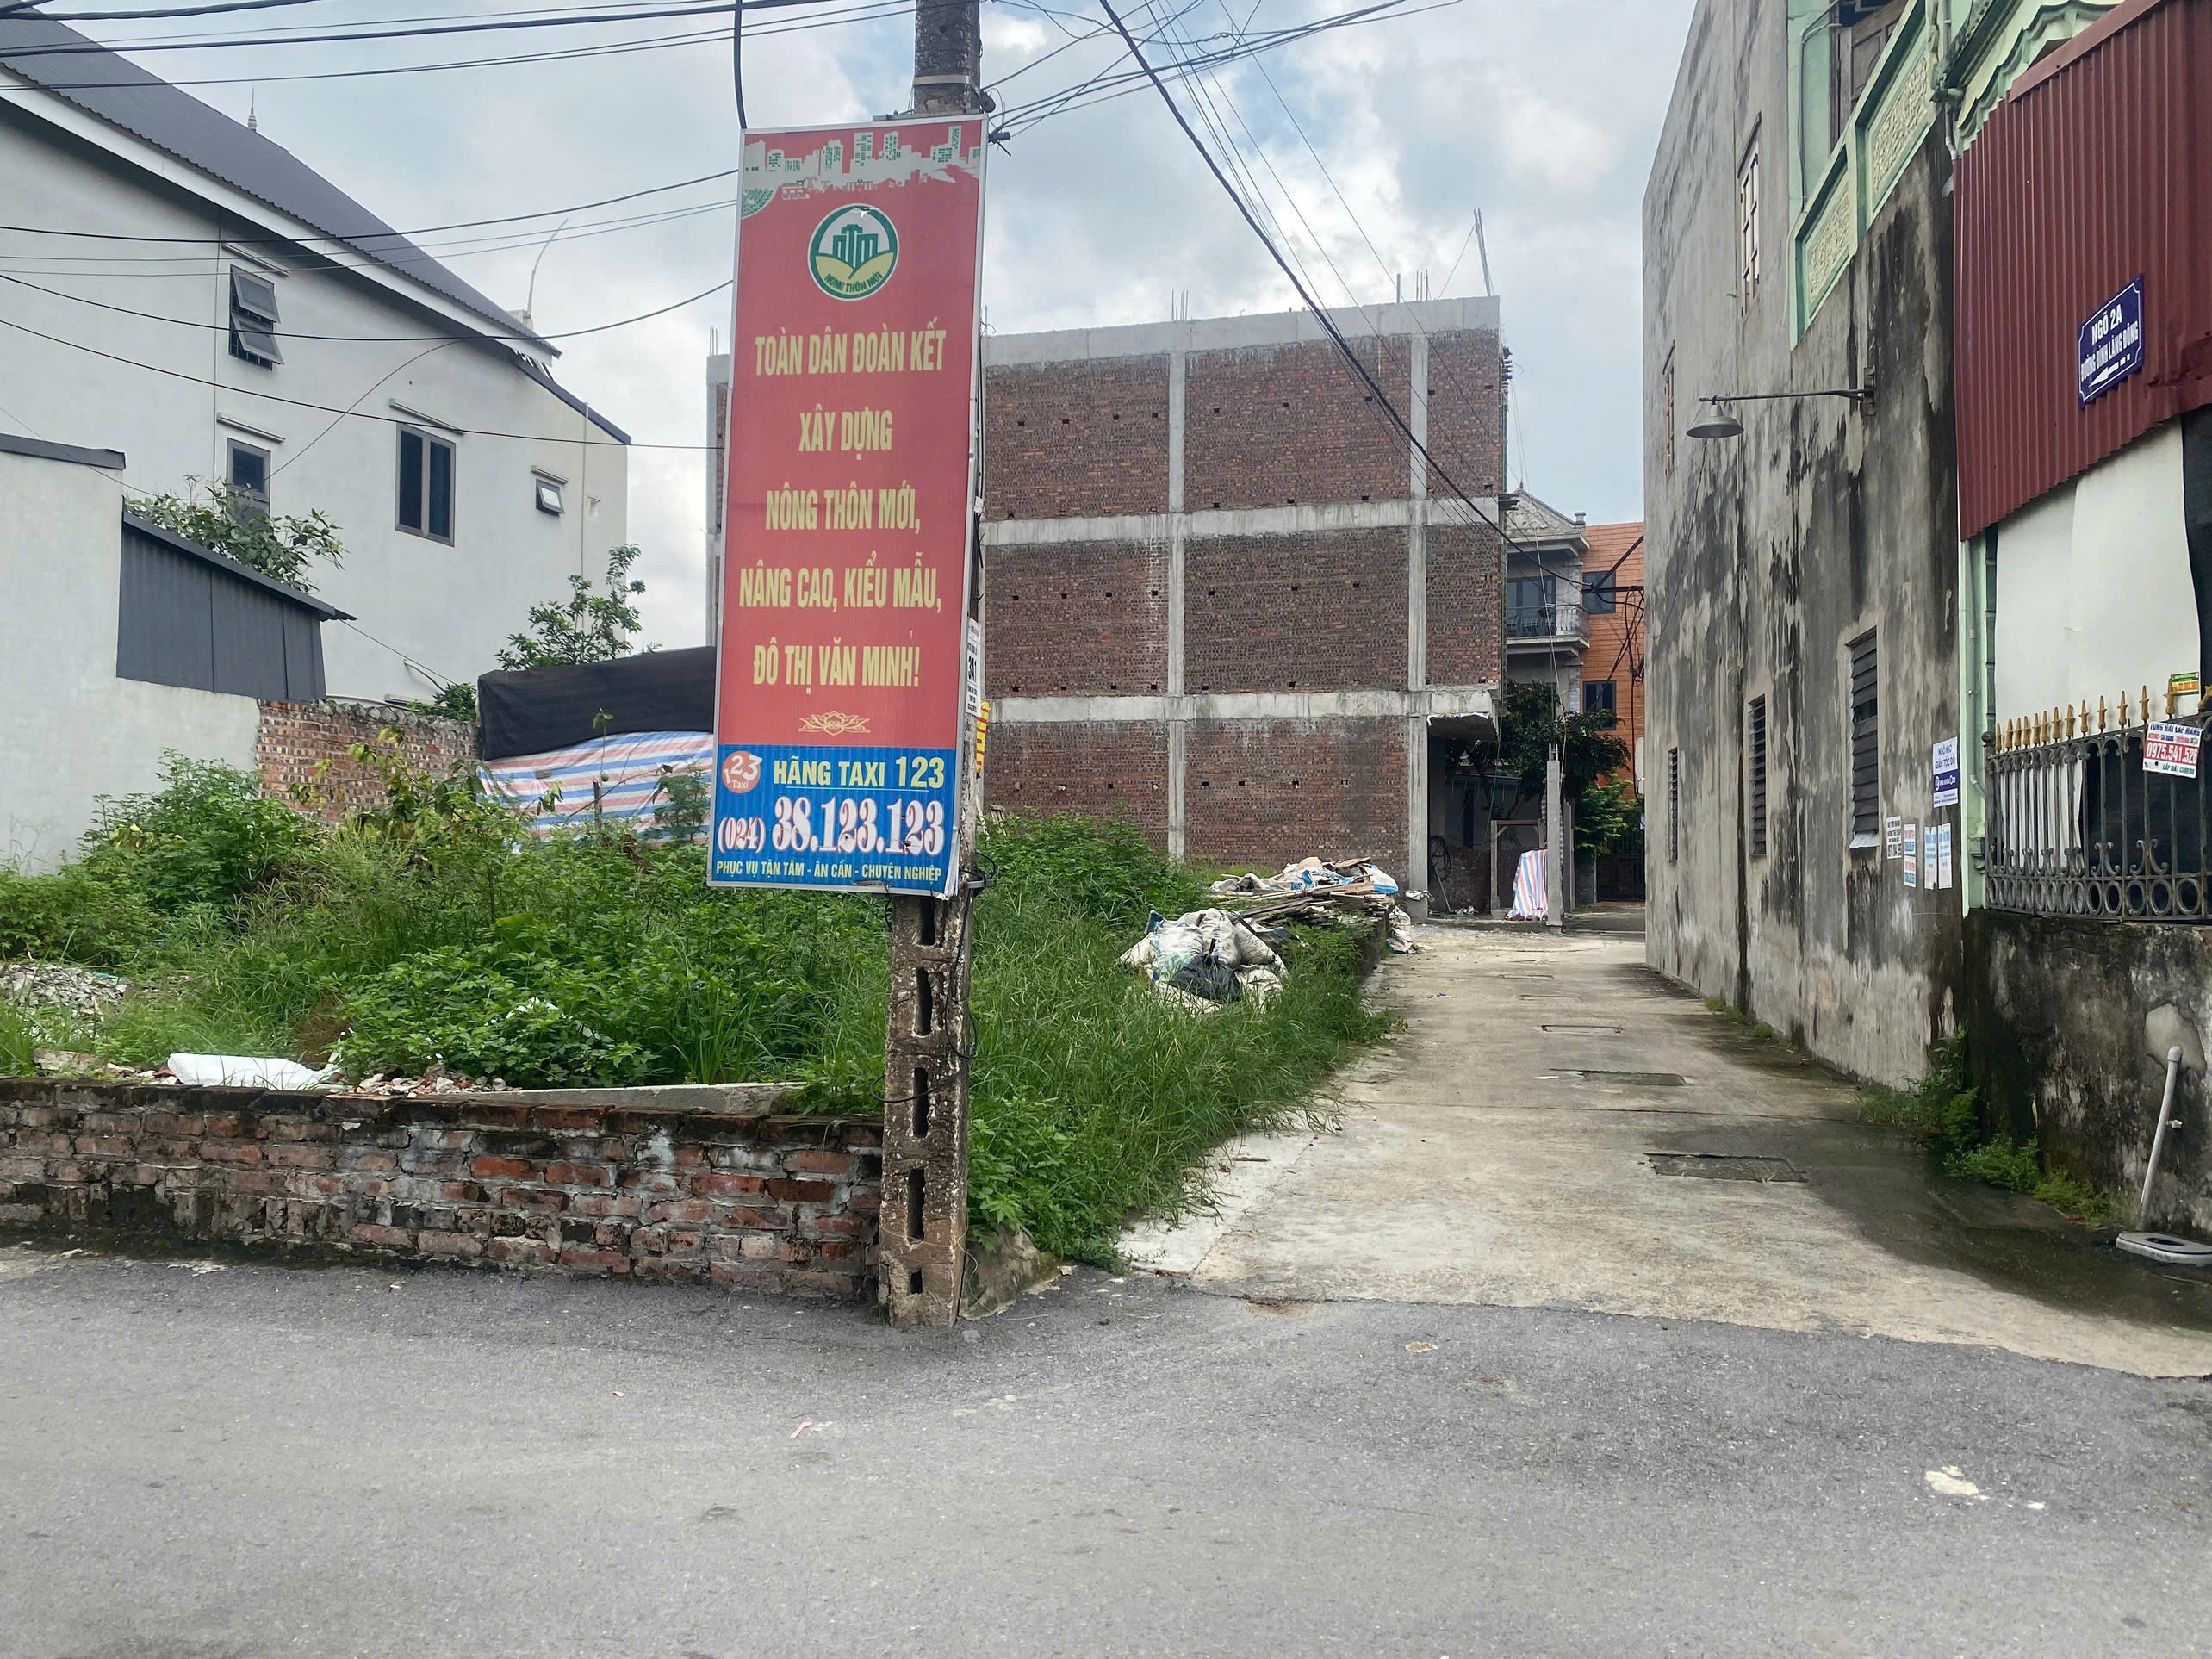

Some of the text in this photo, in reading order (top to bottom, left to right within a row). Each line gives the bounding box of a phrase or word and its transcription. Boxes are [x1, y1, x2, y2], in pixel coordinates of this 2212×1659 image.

[824, 272, 844, 292] NÔNG
[846, 280, 867, 293] THÔN
[2091, 303, 2123, 345] NGÕ 2A
[755, 317, 947, 376] TOÀN DÂN ĐOÀN KẾT
[798, 403, 893, 460] XÂY DỰNG
[766, 480, 921, 534] NÔNG THÔN MỚI,
[739, 551, 941, 613] NÂNG CAO, KIỂU MẪU,
[753, 637, 920, 694] ĐÔ THỊ VĂN MINH!
[724, 755, 763, 784] 123
[774, 755, 945, 789] HÃNG TAXI 123
[2146, 743, 2198, 764] 0975.541.526
[732, 780, 749, 789] Taxi
[718, 796, 945, 855] (024) 38.123.123
[716, 861, 743, 877] PHỤC
[745, 861, 758, 878] VỤ
[761, 858, 780, 879] TẬN
[783, 859, 805, 876] TÂM
[814, 860, 829, 877] ÂN
[861, 862, 901, 880] CHUYÊN
[904, 864, 942, 885] NGHIỆP
